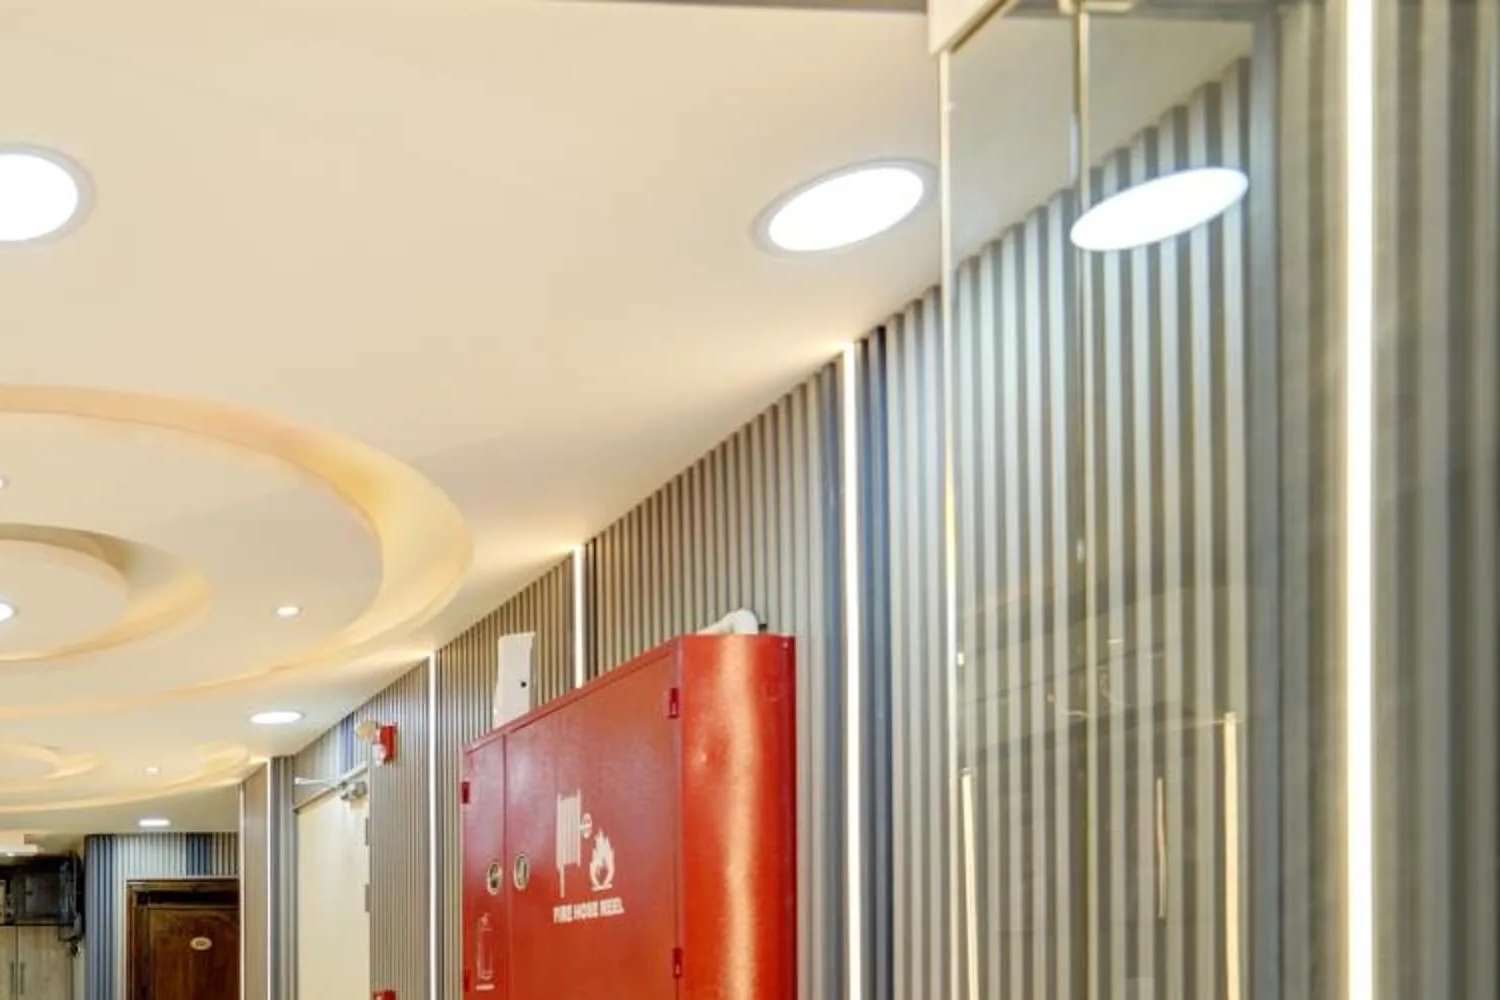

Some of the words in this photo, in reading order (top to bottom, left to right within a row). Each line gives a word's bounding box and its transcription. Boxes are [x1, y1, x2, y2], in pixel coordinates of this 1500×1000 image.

[553, 904, 573, 923] FIRE
[573, 901, 598, 920] HOSE
[599, 897, 624, 917] REEL
